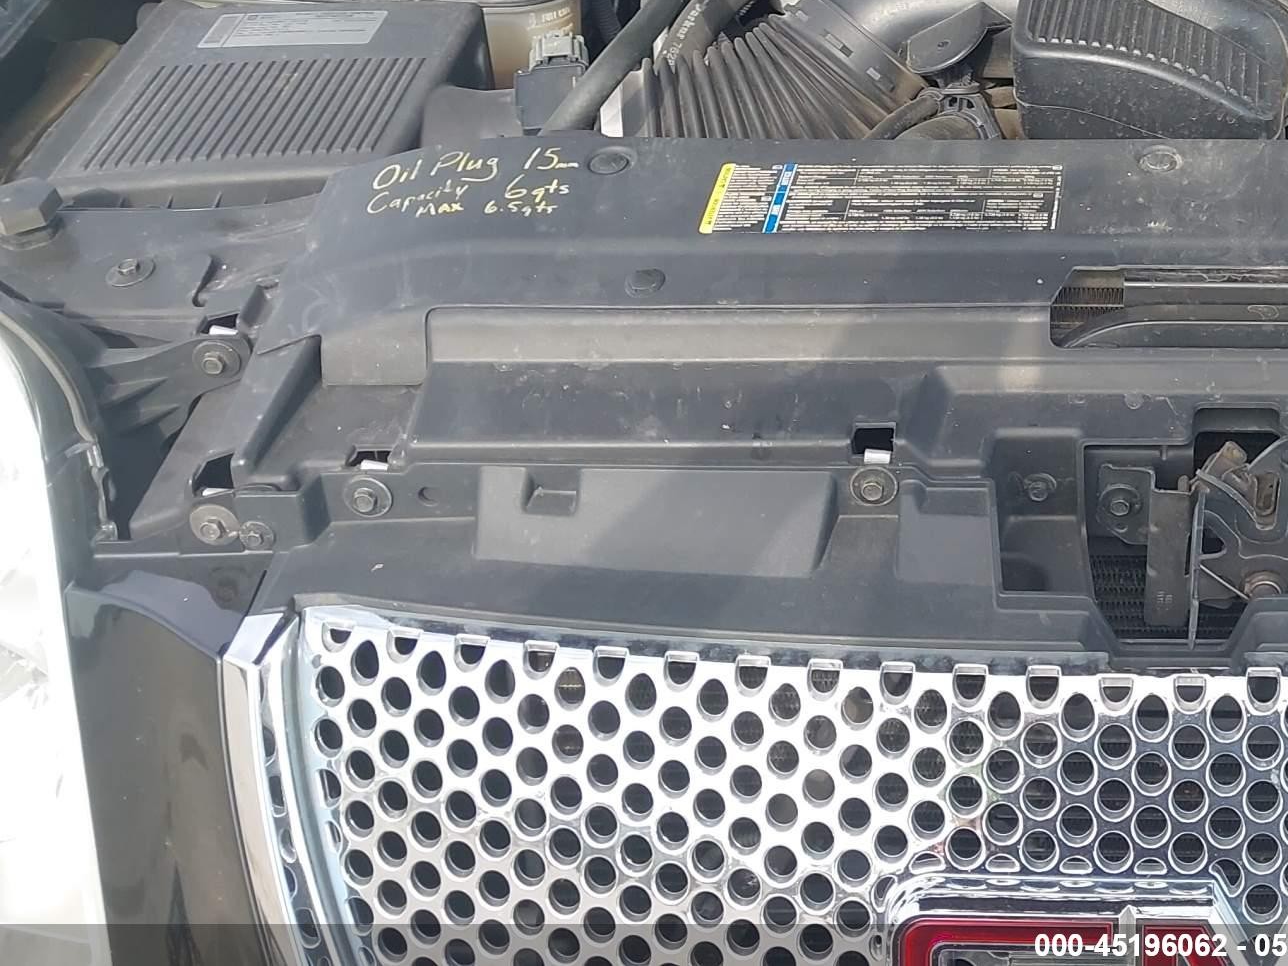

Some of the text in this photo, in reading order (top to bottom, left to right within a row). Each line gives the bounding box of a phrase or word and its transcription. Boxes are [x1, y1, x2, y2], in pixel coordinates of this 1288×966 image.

[372, 158, 423, 190] Oil
[430, 151, 499, 183] Plug
[366, 178, 470, 214] Capacity
